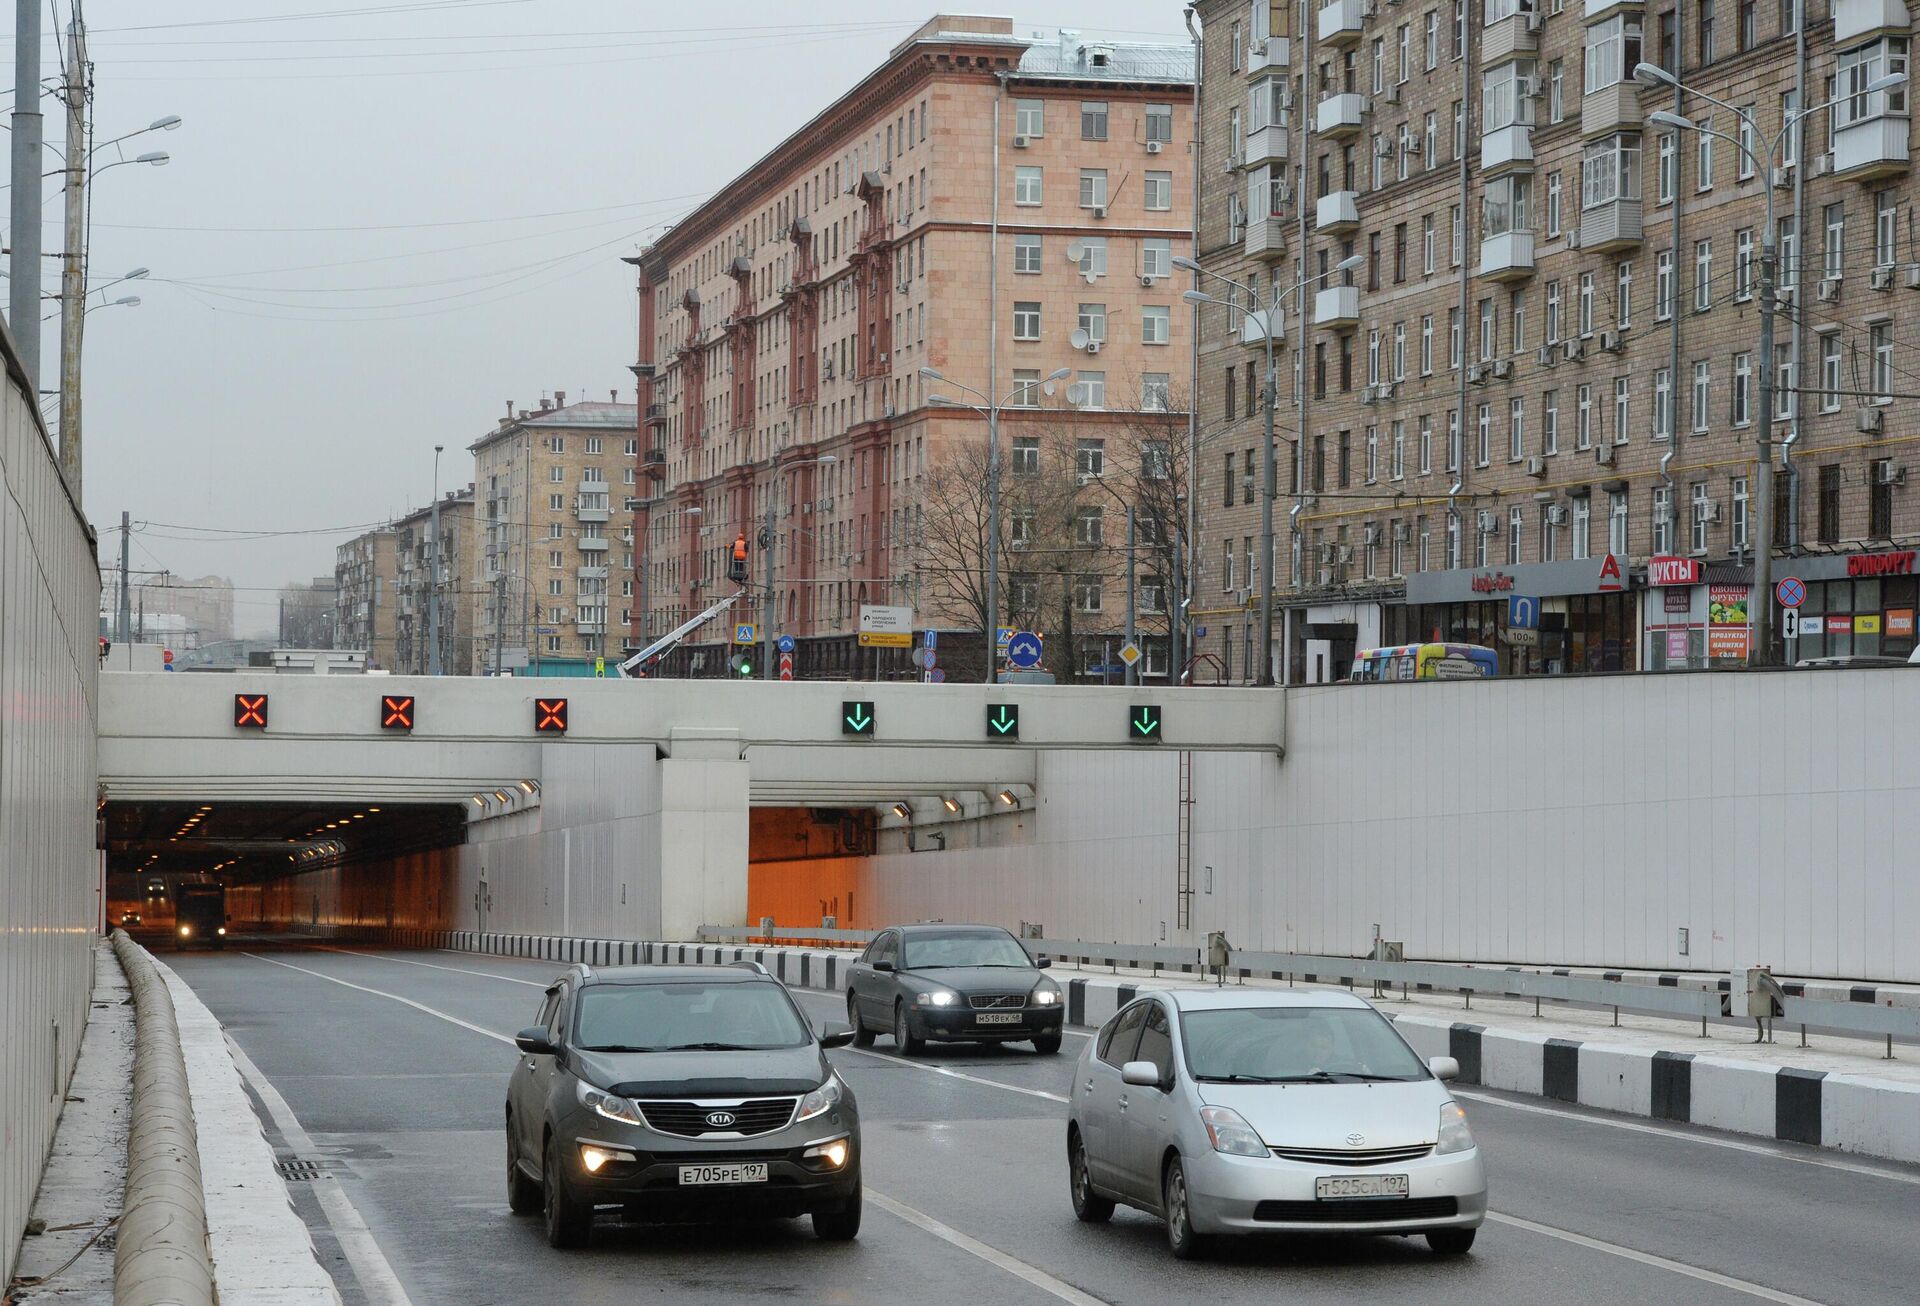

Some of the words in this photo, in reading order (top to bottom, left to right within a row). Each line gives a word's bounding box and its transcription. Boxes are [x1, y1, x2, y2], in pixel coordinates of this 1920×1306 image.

[1710, 594, 1747, 602] ФРУКТЫ
[711, 1115, 730, 1123] KIA
[743, 1165, 763, 1176] 197
[1383, 1177, 1404, 1189] 197
